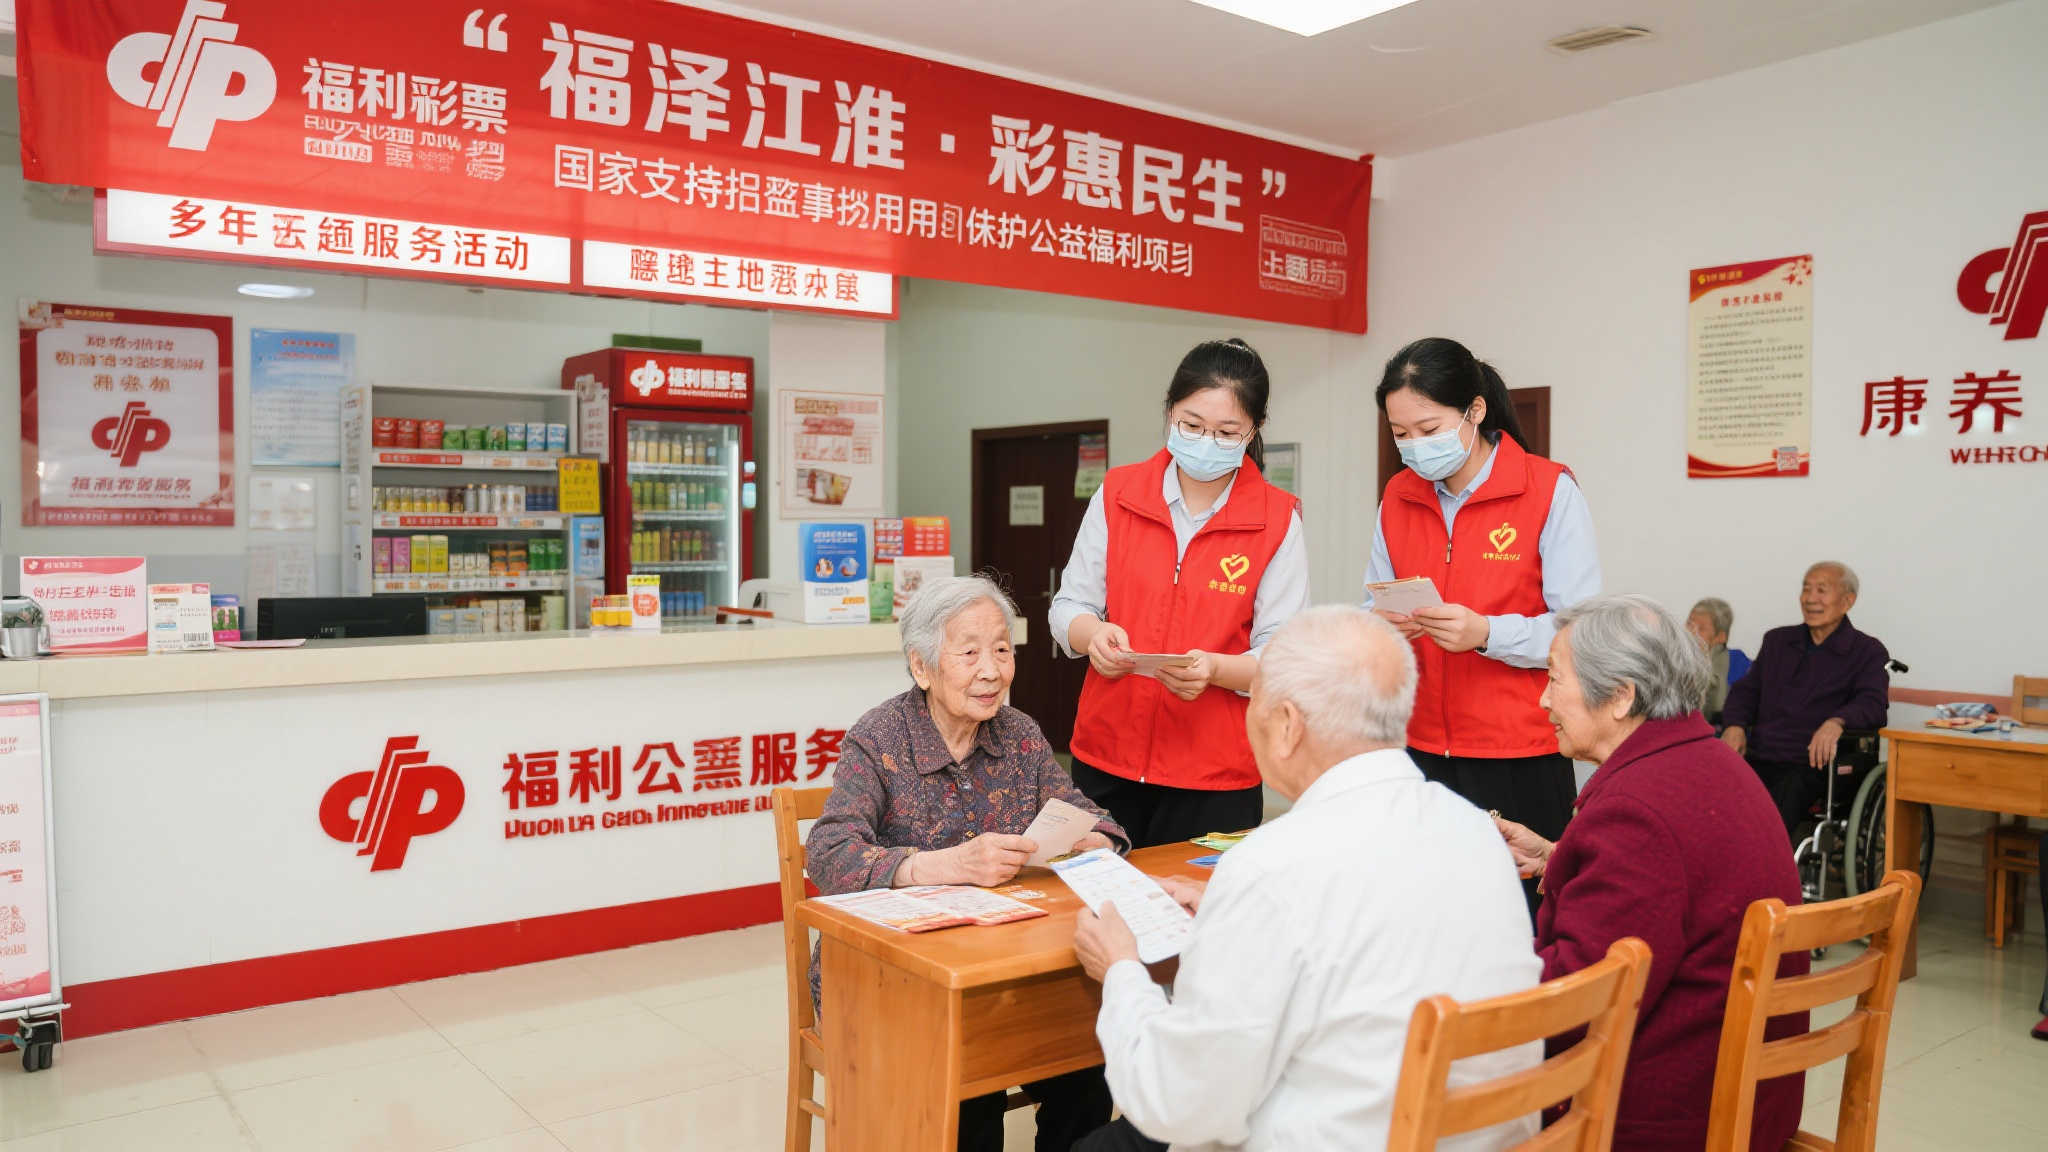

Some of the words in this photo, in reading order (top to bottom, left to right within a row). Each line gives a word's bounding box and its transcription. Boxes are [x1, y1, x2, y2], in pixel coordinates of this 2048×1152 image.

[302, 57, 508, 135] 福利彩票
[1860, 370, 2023, 437] 康养
